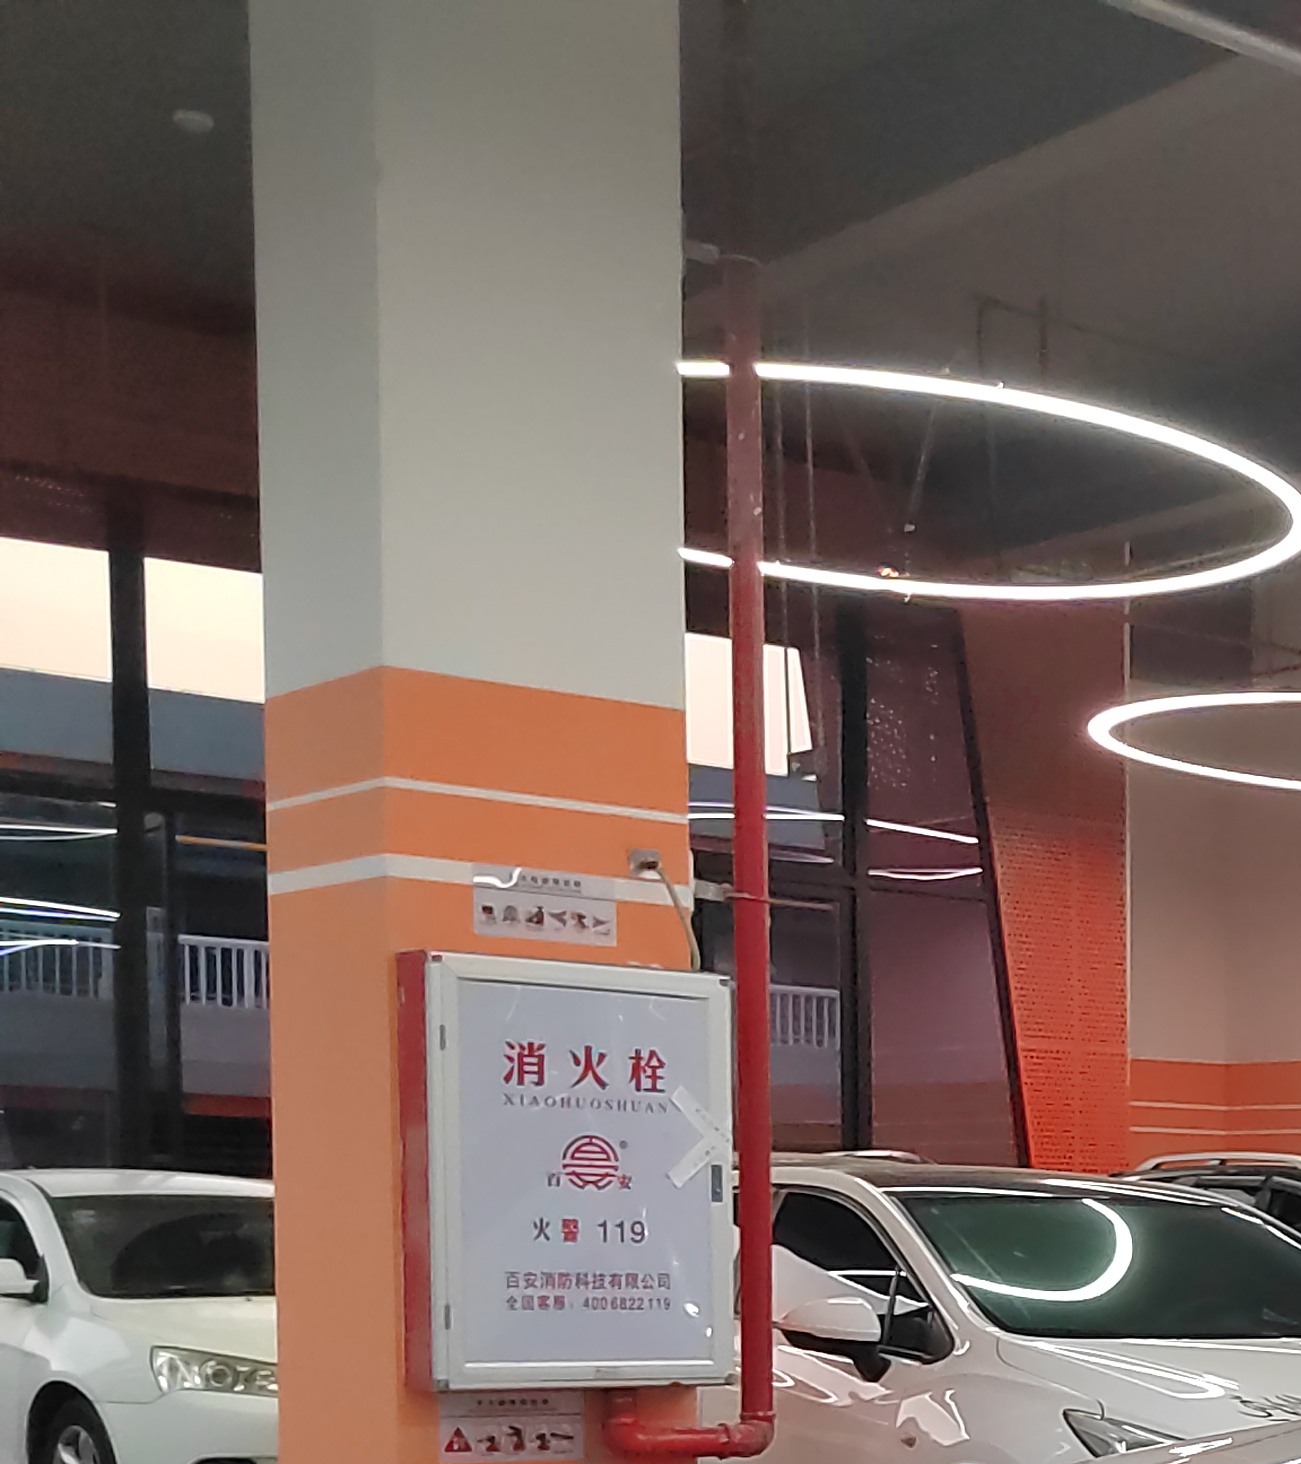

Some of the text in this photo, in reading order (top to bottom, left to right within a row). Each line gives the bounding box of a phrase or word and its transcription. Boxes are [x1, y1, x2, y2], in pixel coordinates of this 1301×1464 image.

[503, 1040, 667, 1093] 消火栓
[502, 1092, 669, 1115] XIAOHUOSHUAN
[597, 1219, 649, 1244] 119
[504, 1270, 672, 1291] 百安消防科技有限公司
